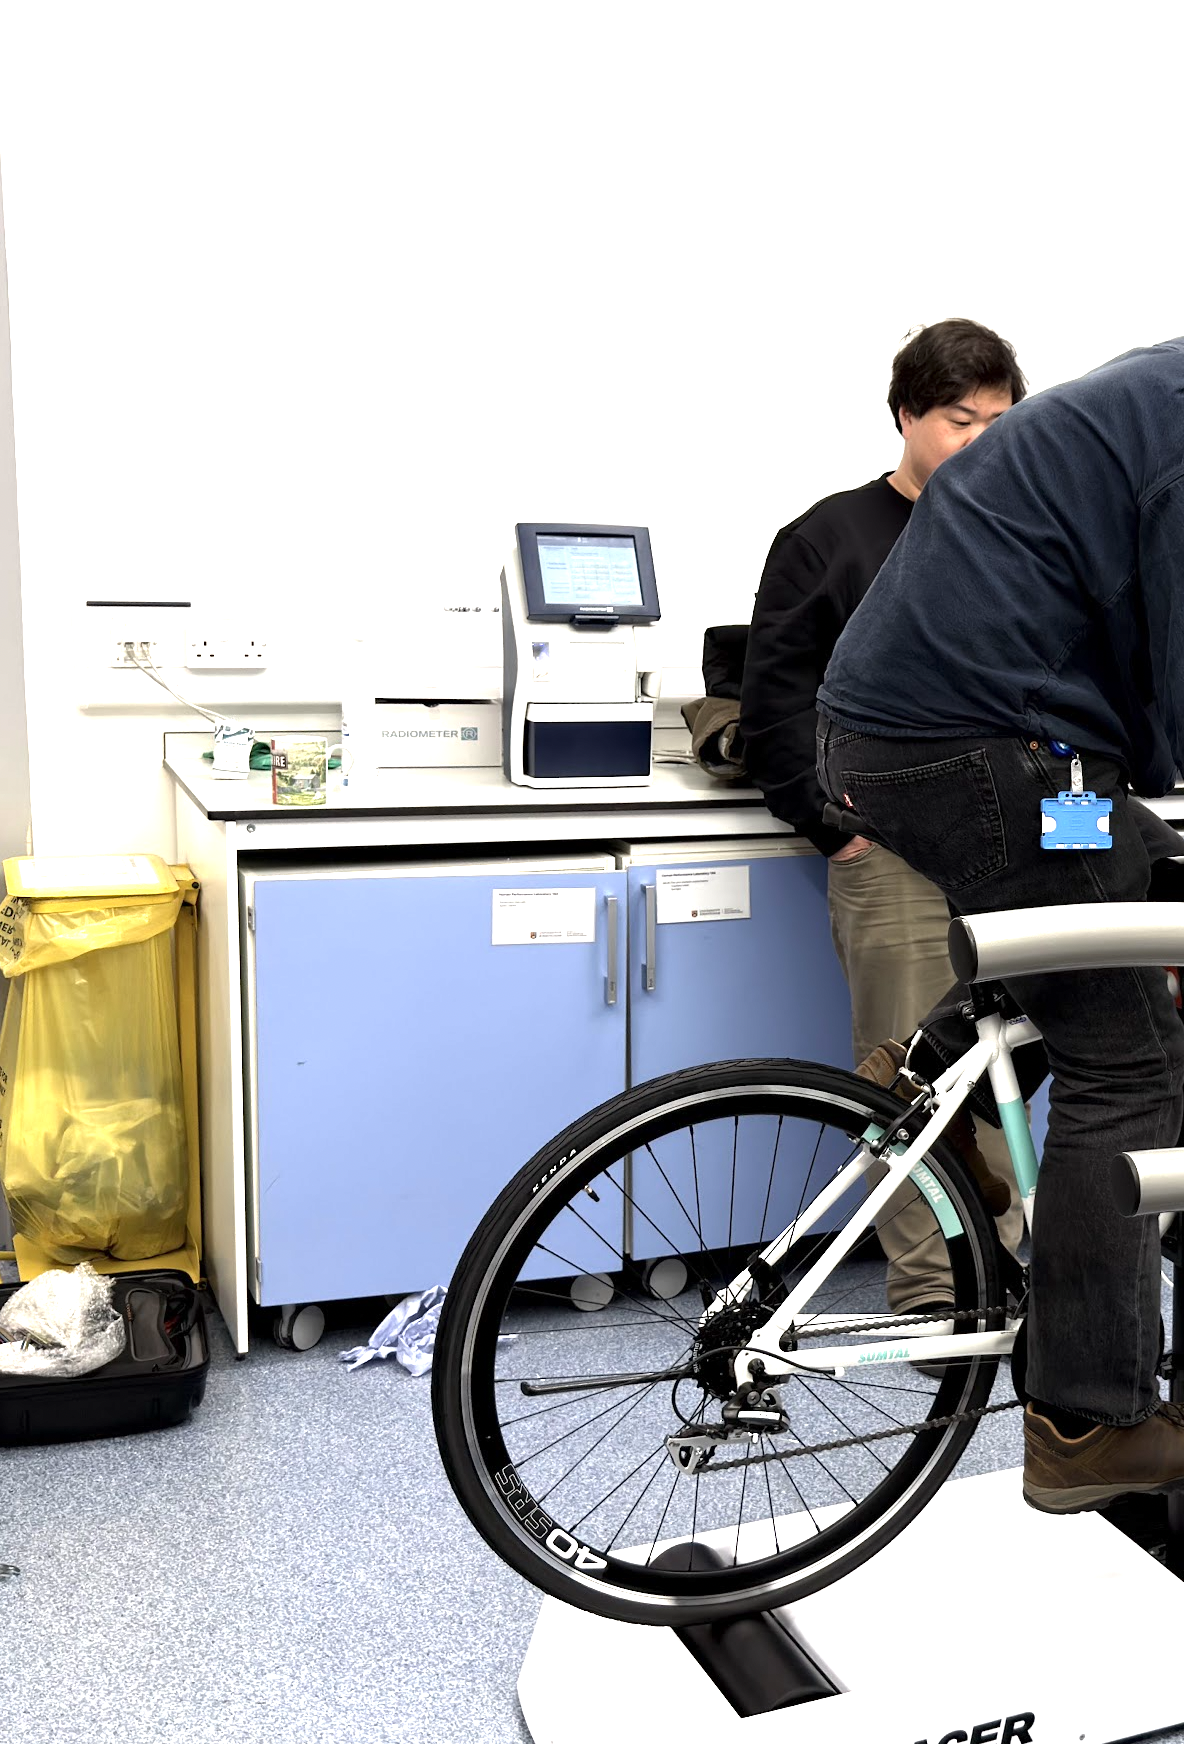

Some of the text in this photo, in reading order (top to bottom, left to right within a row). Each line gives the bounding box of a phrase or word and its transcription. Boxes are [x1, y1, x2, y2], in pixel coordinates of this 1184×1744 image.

[382, 730, 459, 739] RADIOMETER
[273, 755, 286, 768] IRE
[532, 1148, 577, 1193] KENDA
[912, 1161, 944, 1204] UMTAL
[858, 1347, 911, 1364] SUMTAL
